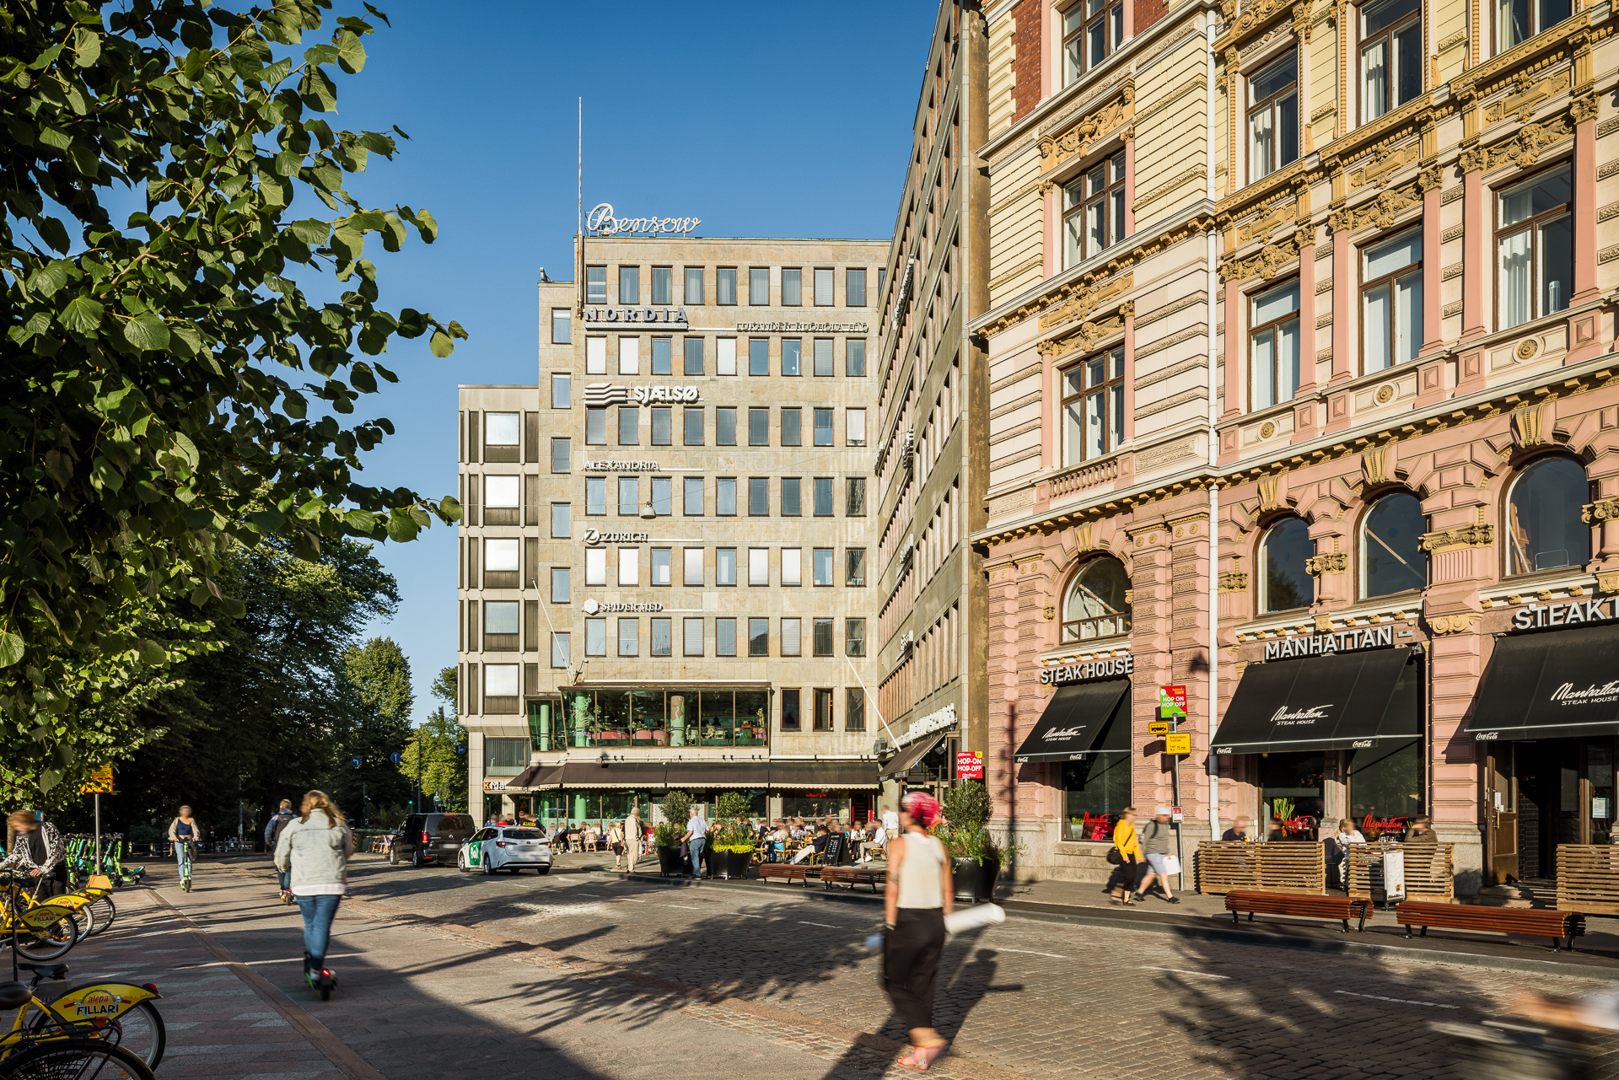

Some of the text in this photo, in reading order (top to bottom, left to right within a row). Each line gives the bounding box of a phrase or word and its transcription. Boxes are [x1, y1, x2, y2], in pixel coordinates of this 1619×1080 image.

[588, 203, 702, 235] Bensow
[585, 306, 688, 322] NORDIA
[634, 385, 698, 405] SJÆLSØ
[584, 460, 660, 471] ALEXANDRIA
[600, 532, 648, 543] ZURICH
[1514, 598, 1608, 630] STEAK
[1265, 626, 1393, 660] MANHATTAN
[1041, 657, 1134, 684] STEAK HOUSE
[1591, 695, 1618, 704] HOUSE
[1270, 704, 1334, 722] Manhattan
[1362, 813, 1409, 829] Manhattan
[88, 995, 109, 1004] alepa
[77, 1004, 119, 1016] FILLARI
